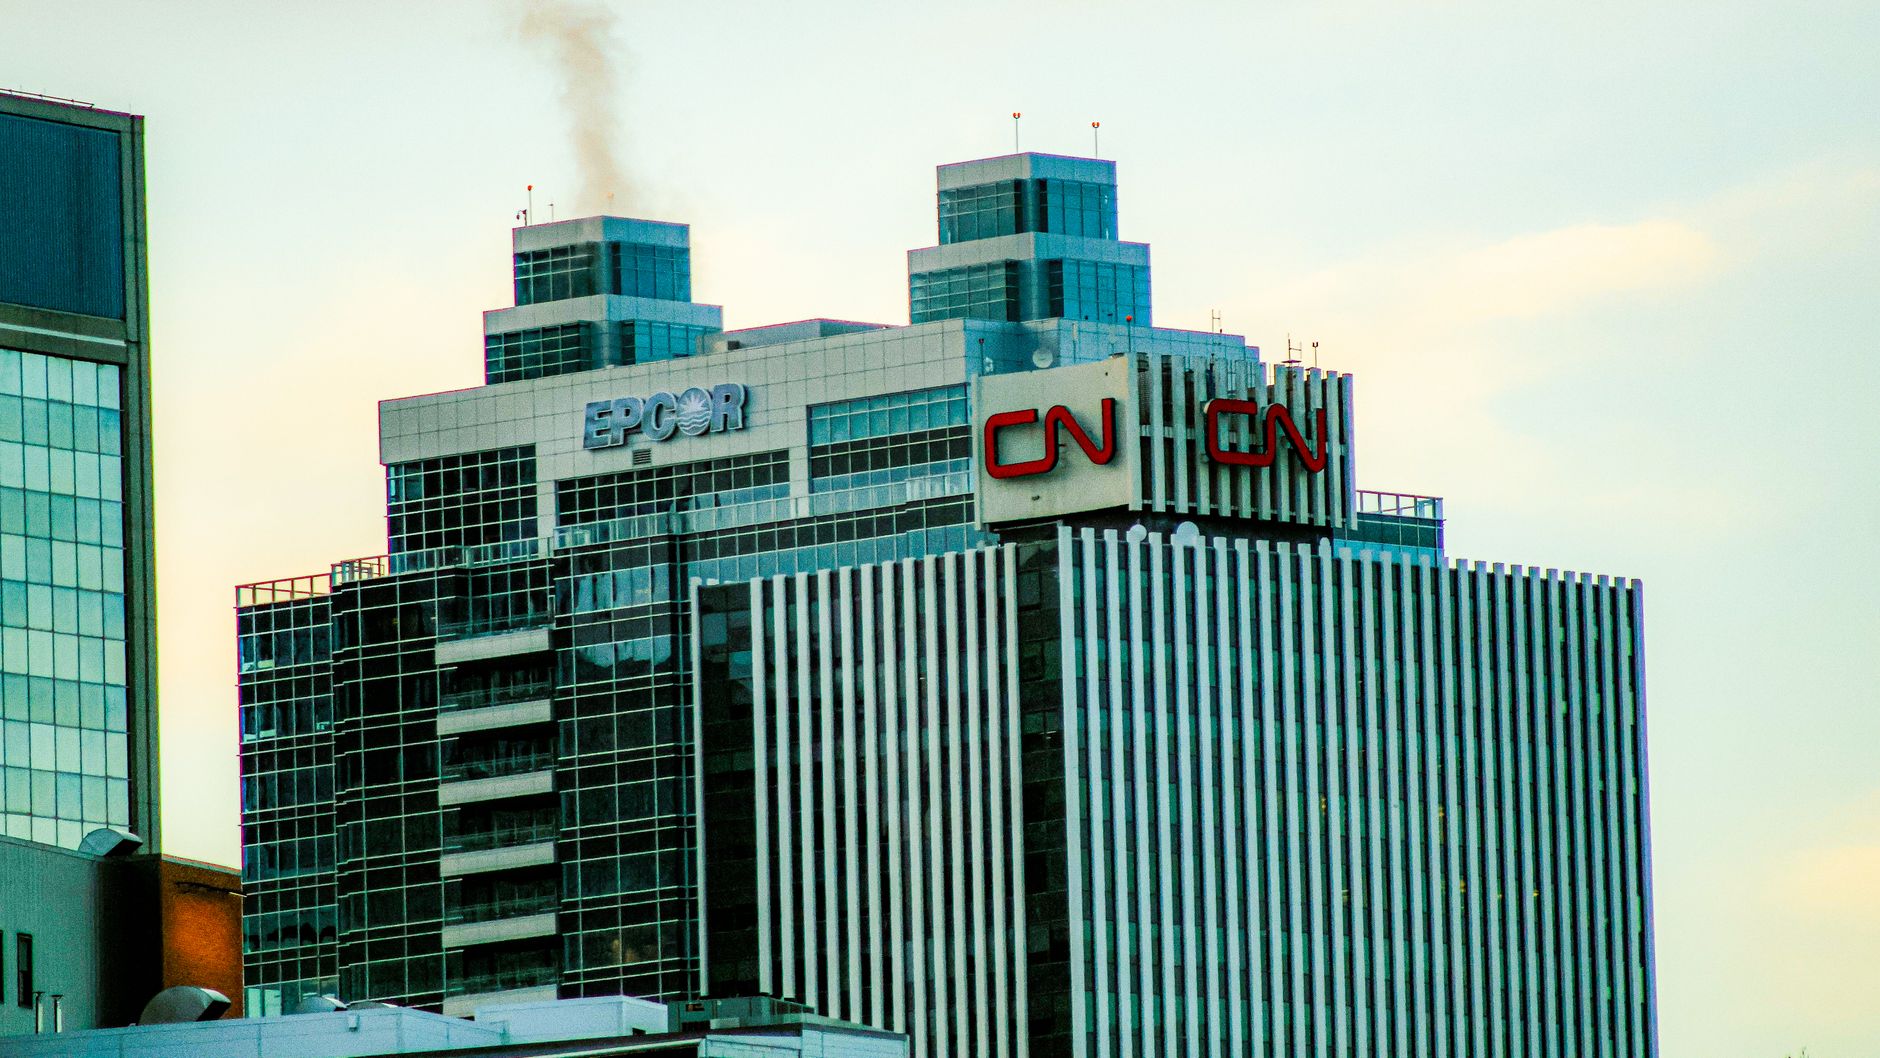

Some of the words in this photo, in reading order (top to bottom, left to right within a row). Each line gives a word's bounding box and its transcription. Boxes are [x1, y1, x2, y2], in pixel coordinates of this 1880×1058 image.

[583, 383, 747, 450] EPCOR
[984, 398, 1116, 480] CN
[1207, 398, 1327, 473] CN
